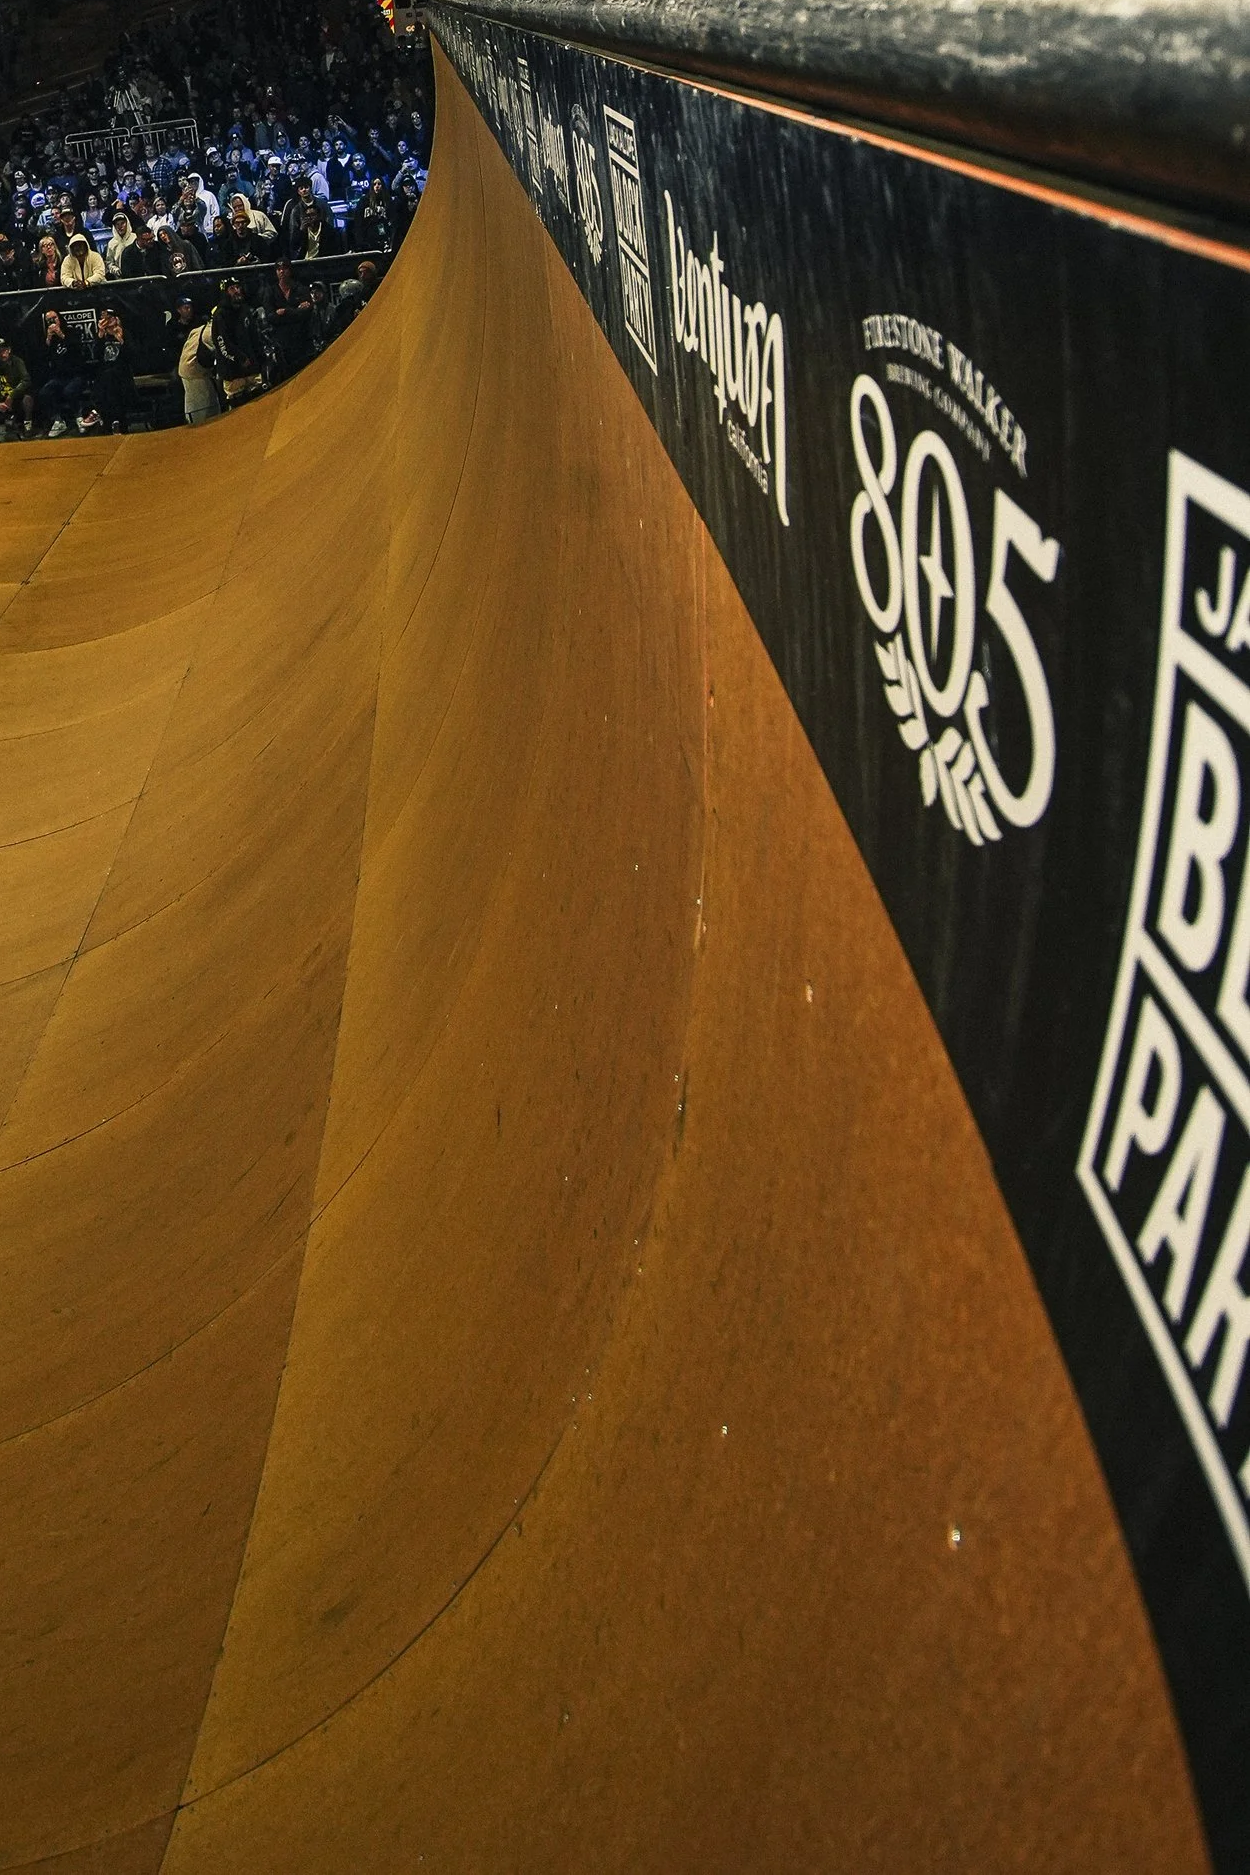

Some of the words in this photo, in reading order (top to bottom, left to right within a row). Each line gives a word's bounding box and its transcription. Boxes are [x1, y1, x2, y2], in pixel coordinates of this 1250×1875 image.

[862, 314, 945, 370] FIRESTONE
[946, 341, 1028, 478] WALKER
[850, 374, 1061, 828] 805
